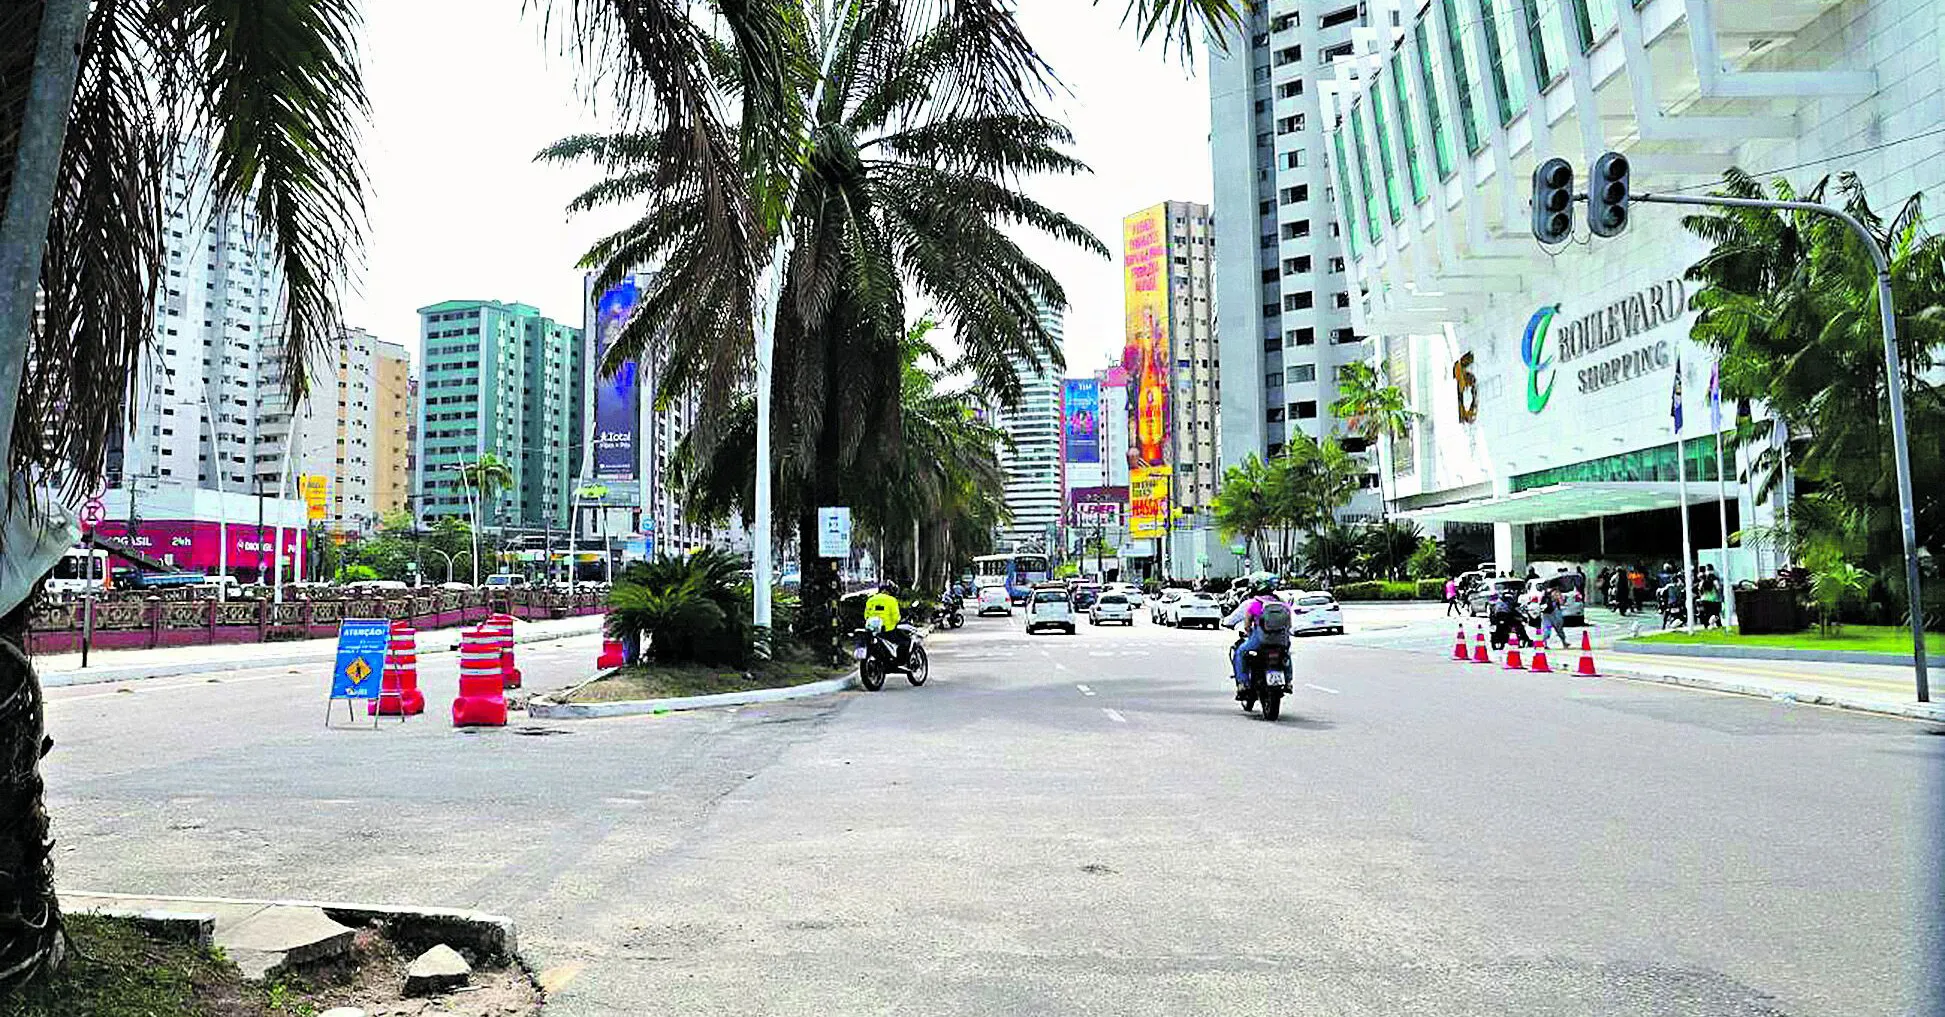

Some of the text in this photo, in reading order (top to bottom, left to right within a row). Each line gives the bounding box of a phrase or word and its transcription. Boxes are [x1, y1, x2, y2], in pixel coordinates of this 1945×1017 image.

[1558, 278, 1685, 363] BOULEVARD
[1578, 339, 1670, 394] SHOPPING
[343, 627, 386, 637] ATENÇÃO!
